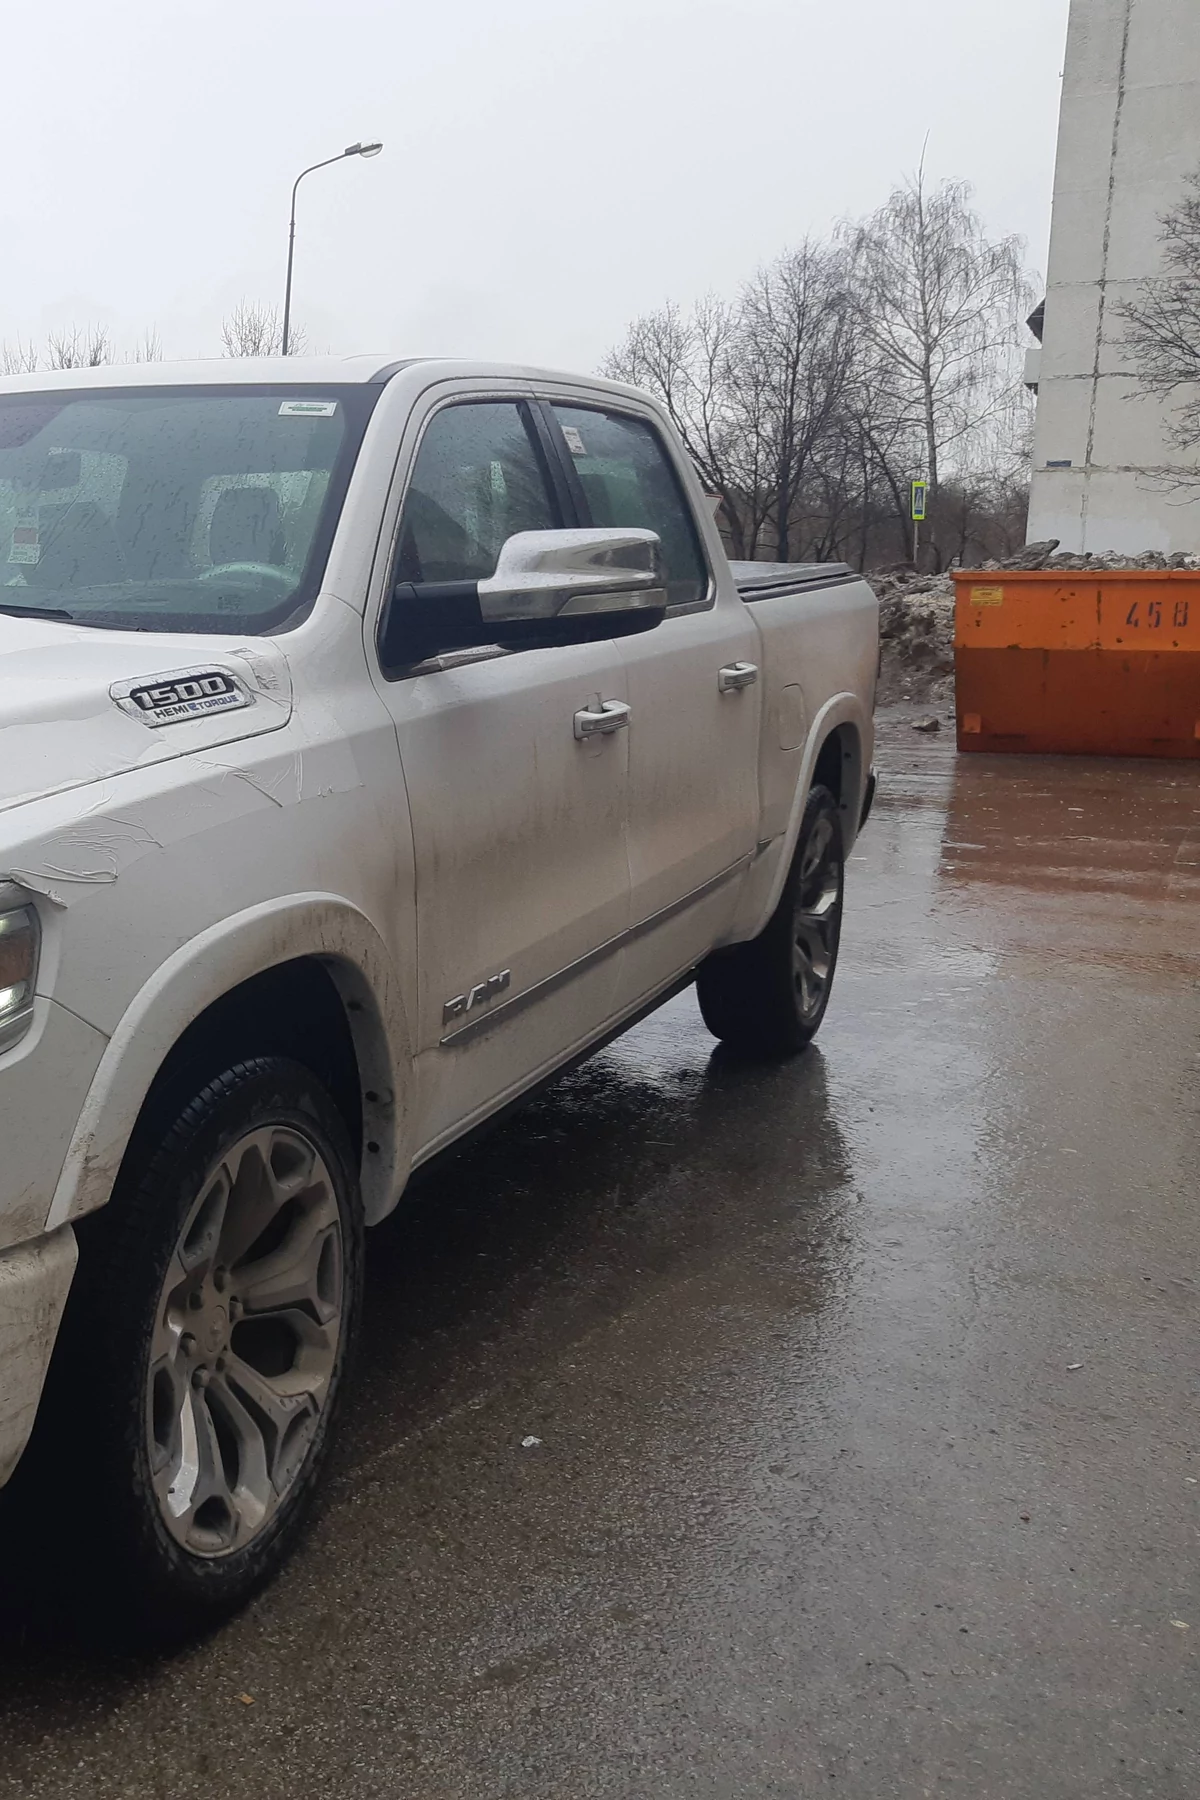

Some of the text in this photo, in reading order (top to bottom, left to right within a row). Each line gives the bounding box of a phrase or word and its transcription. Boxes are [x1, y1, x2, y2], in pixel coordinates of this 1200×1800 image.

[134, 676, 227, 709] 1500
[153, 704, 190, 719] HEMI
[441, 968, 511, 1027] RAM
